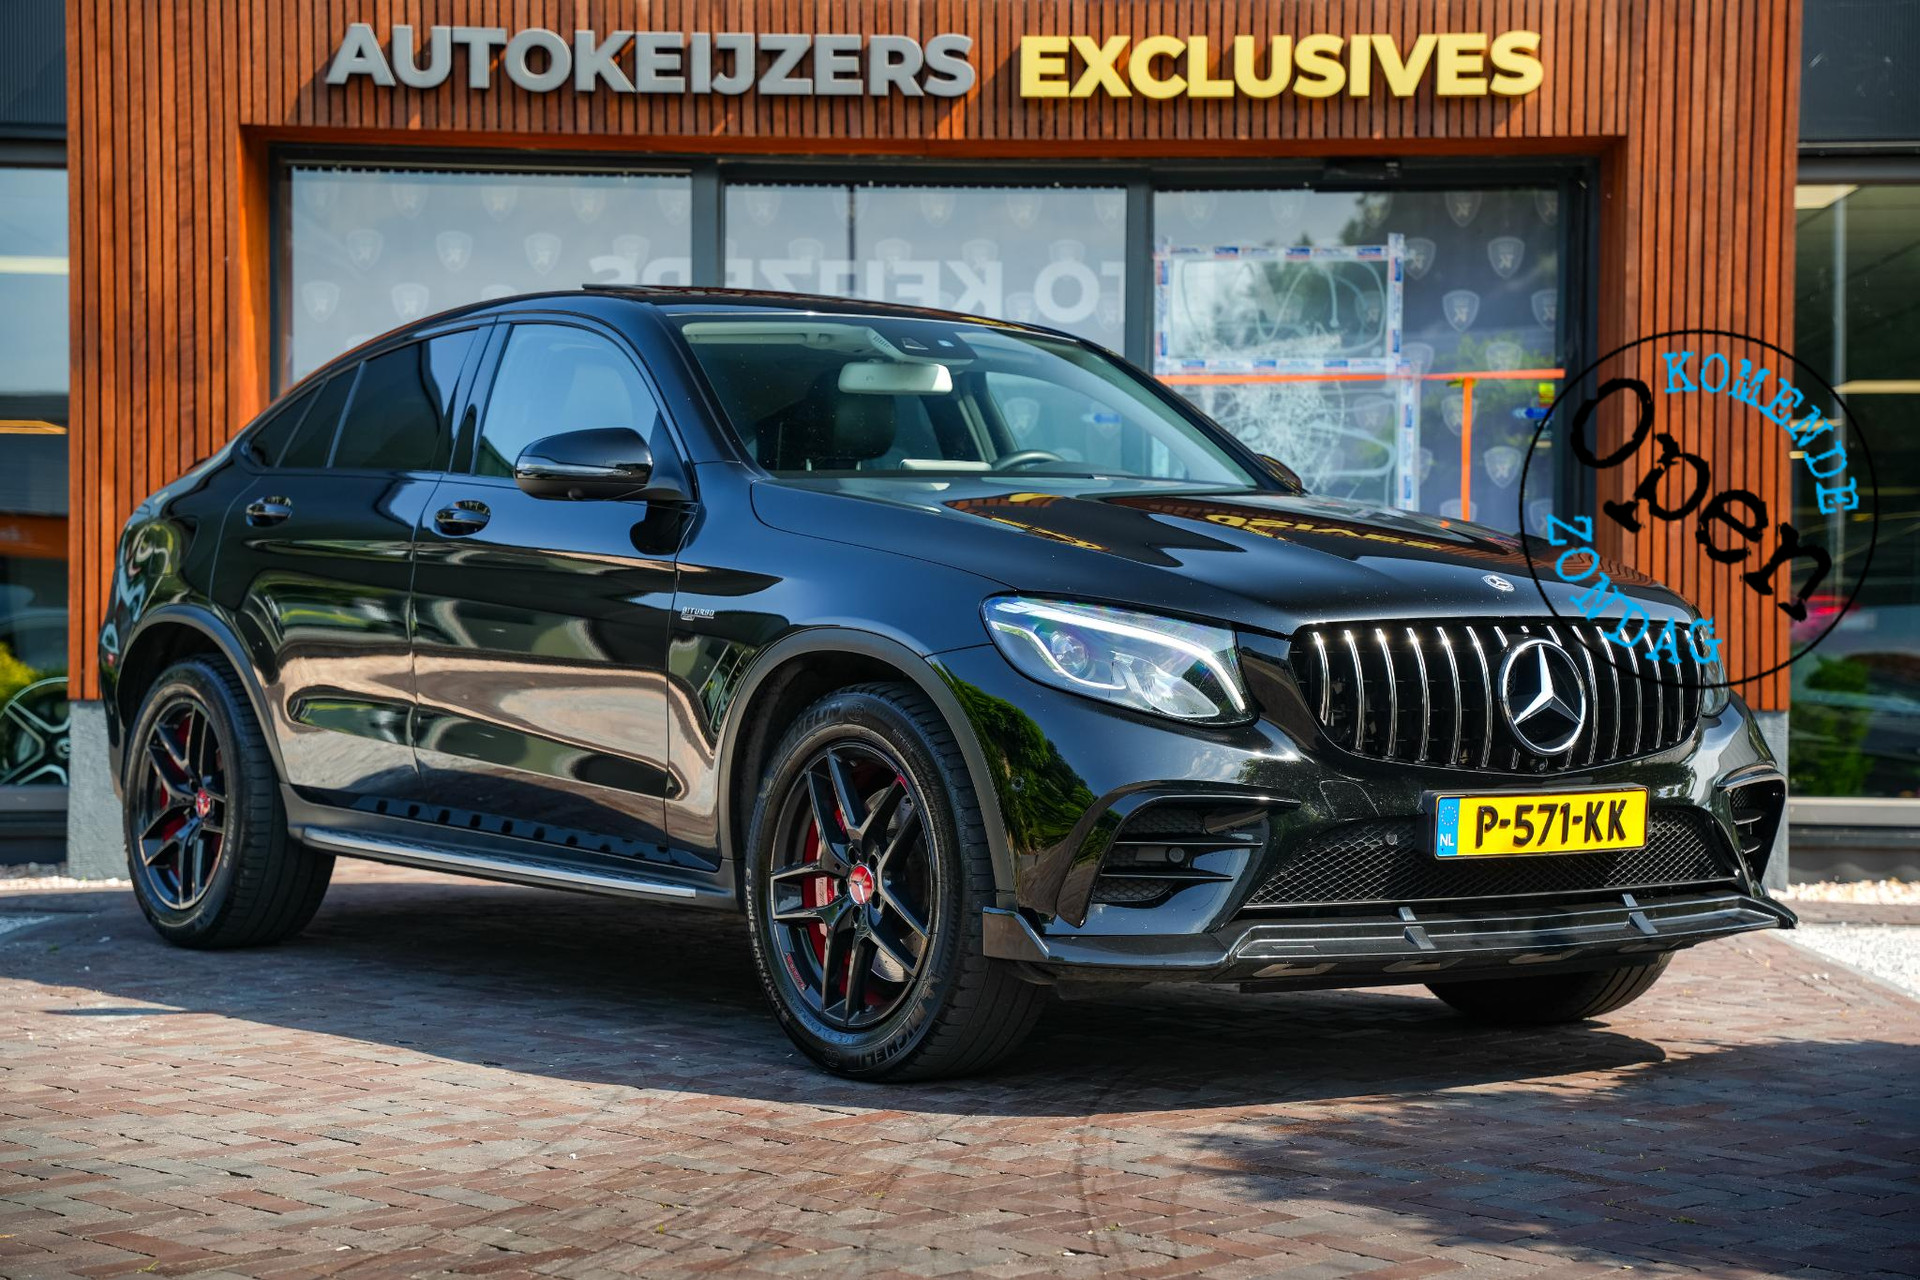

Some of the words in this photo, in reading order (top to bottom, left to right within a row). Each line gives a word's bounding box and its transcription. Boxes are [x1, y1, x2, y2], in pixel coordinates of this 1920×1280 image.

[325, 22, 976, 97] AUTOKEIJZERS
[1019, 30, 1544, 98] EXCLUSIVES
[1439, 833, 1455, 847] NL
[1475, 799, 1628, 849] P-571-KK
